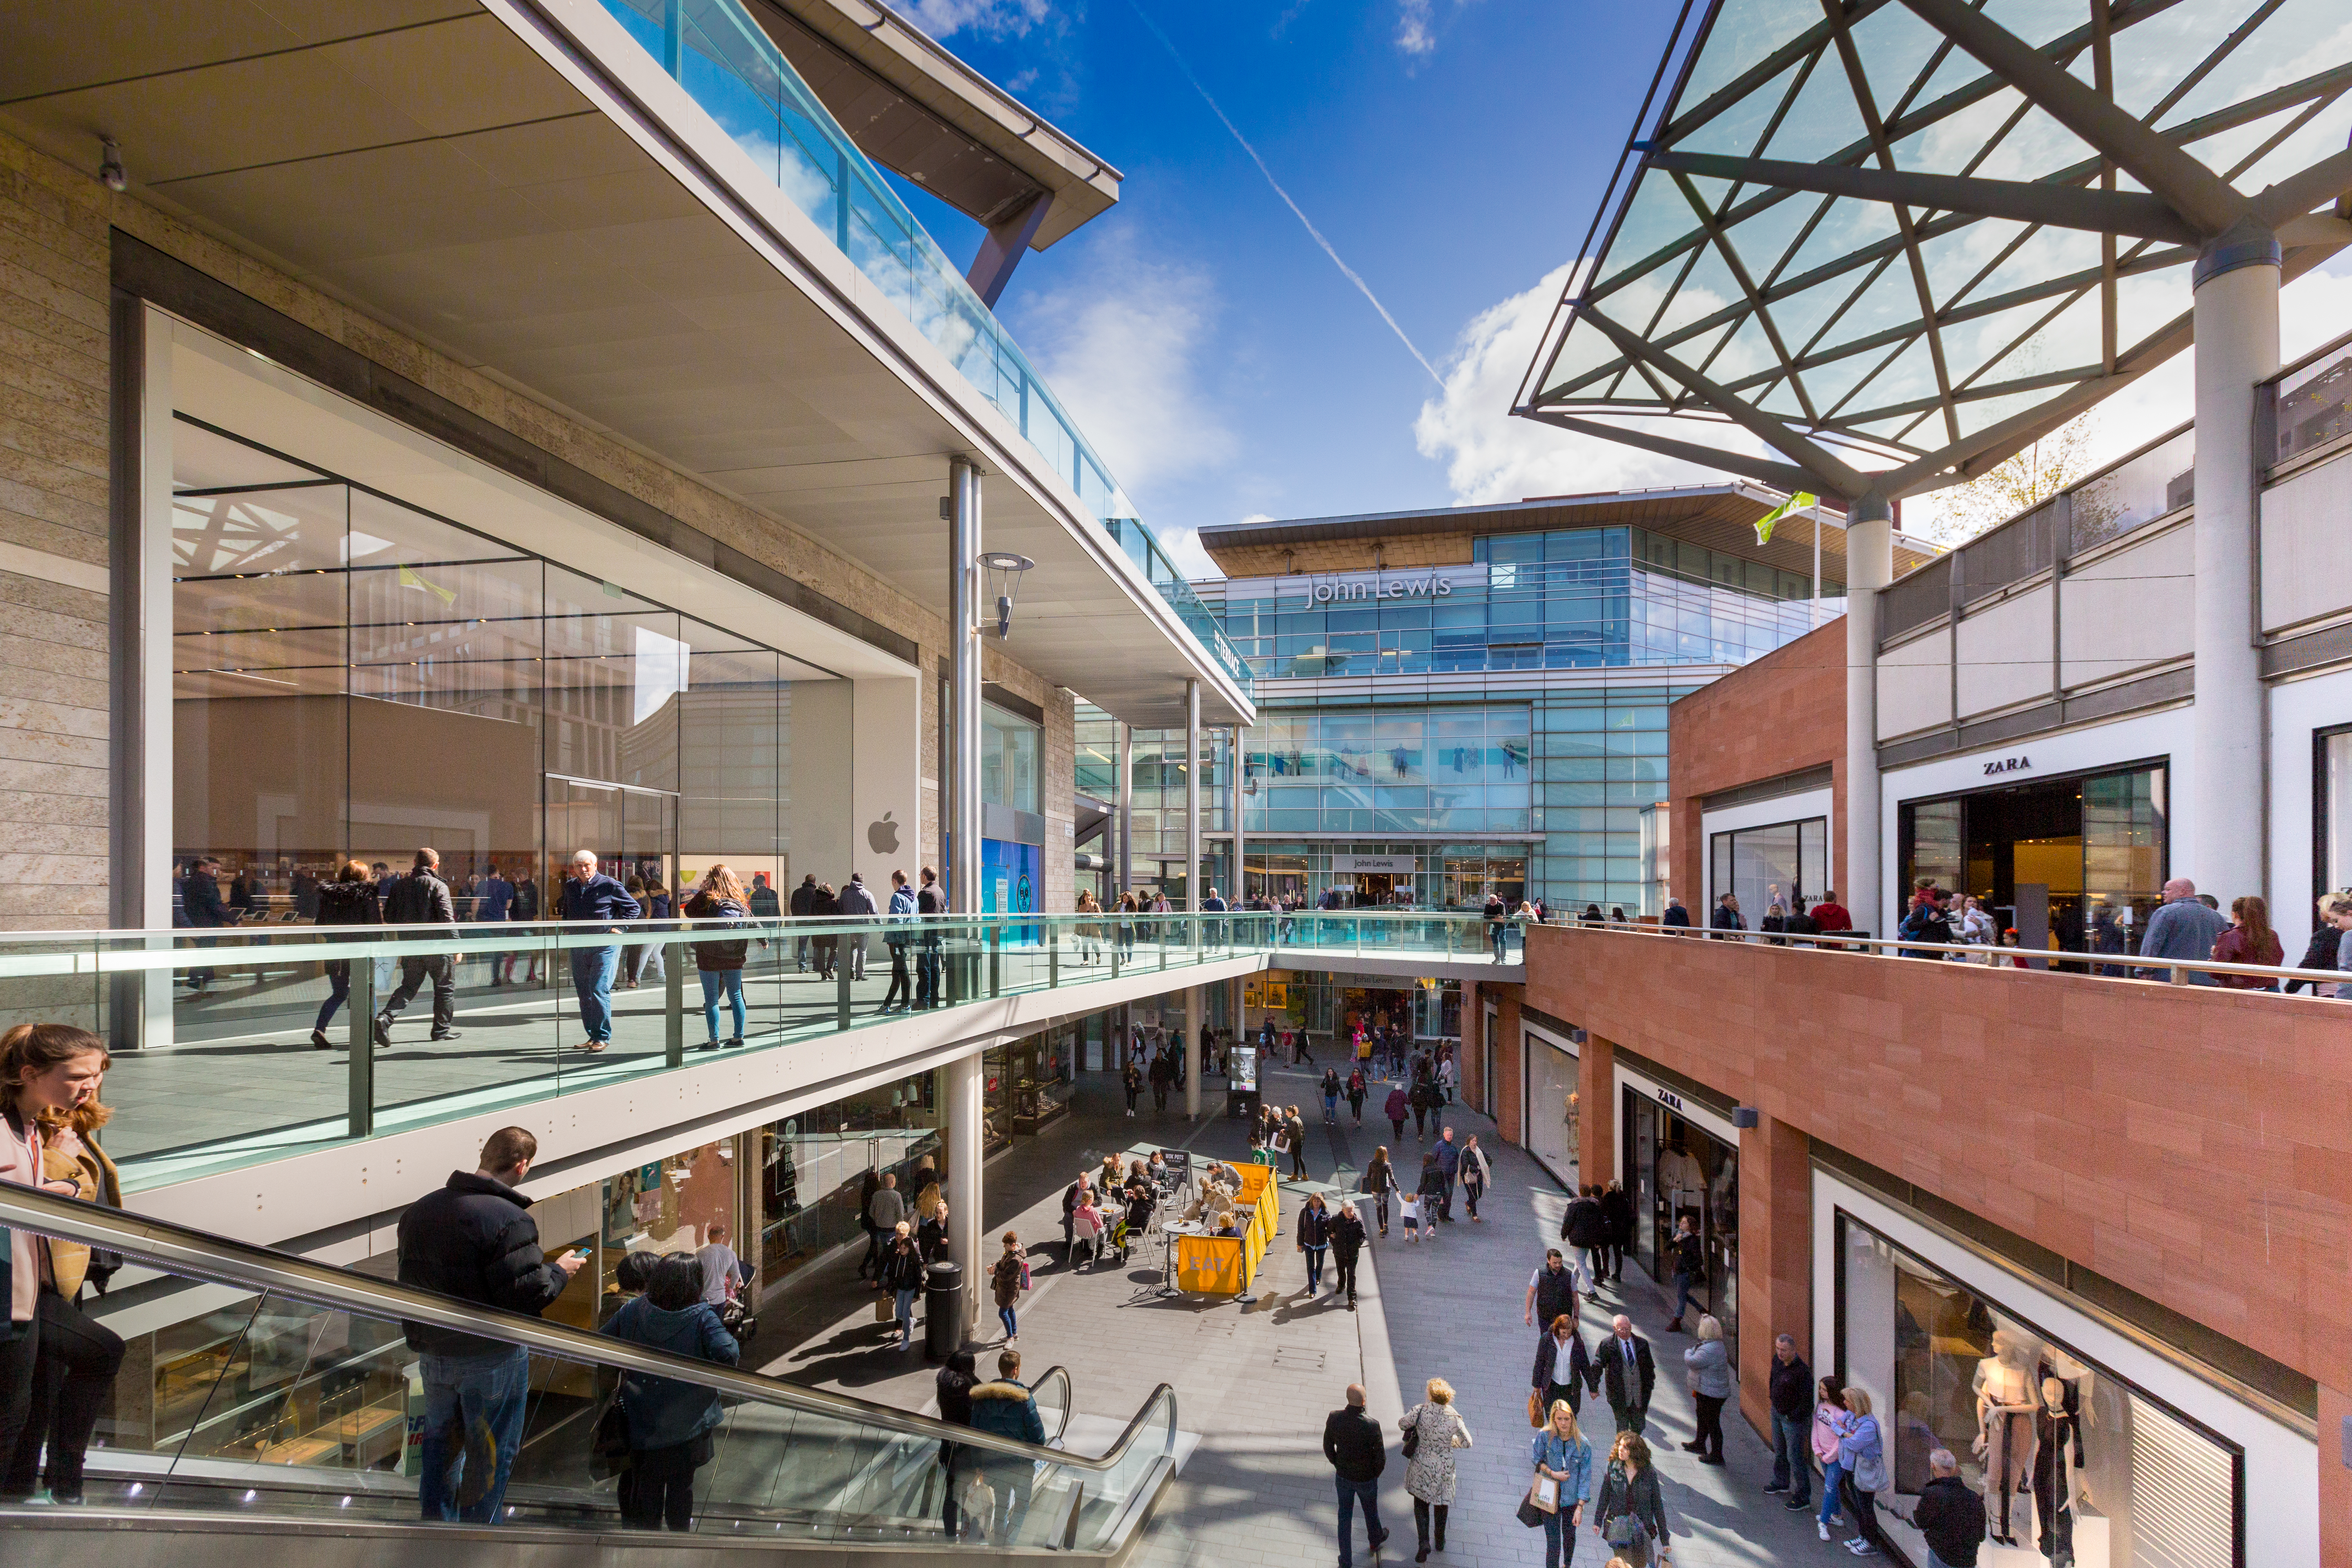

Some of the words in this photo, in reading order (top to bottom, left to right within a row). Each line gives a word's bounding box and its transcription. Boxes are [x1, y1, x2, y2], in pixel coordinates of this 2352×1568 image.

[1304, 576, 1366, 609] John
[1376, 570, 1451, 598] Lewis
[1220, 636, 1240, 678] TERRACE
[1984, 756, 2032, 775] ZARA
[1354, 859, 1371, 868] John
[1354, 975, 1372, 984] John
[1658, 1088, 1683, 1111] ZARA
[785, 1140, 797, 1153] GOOD
[785, 1151, 797, 1163] MOOD
[1190, 1256, 1227, 1272] EAT.
